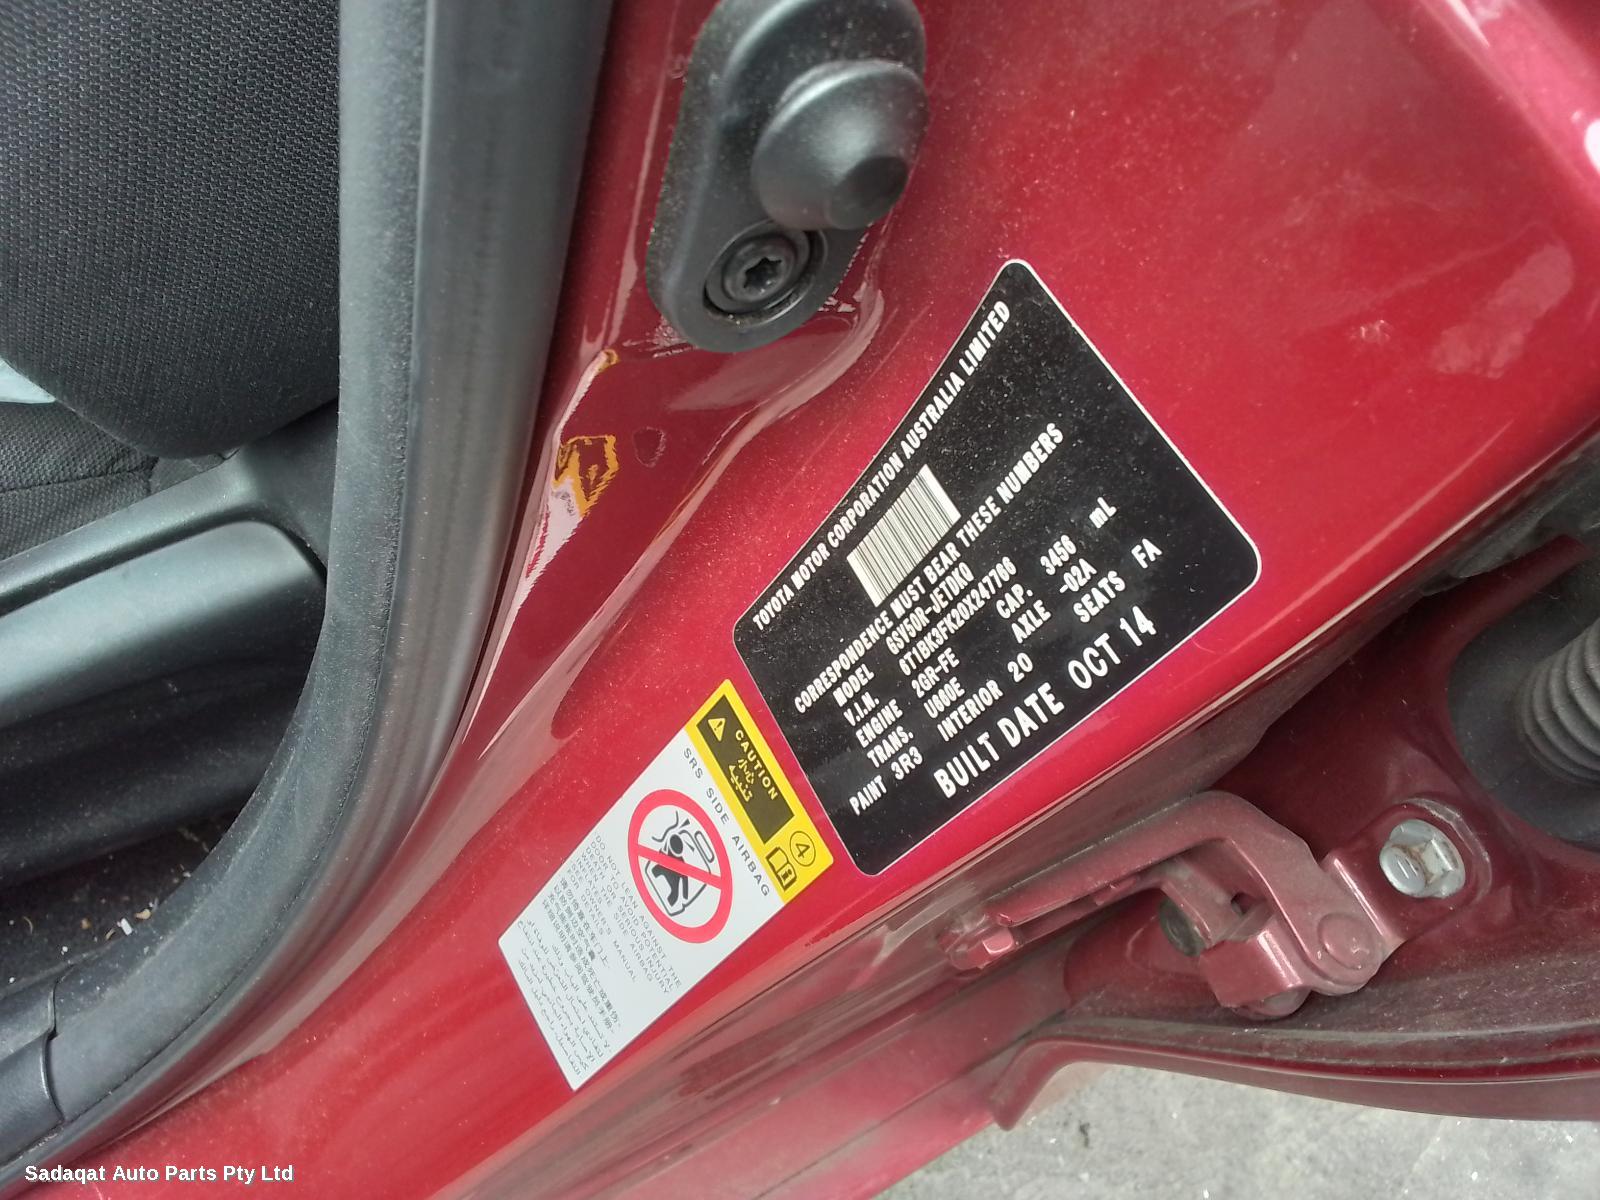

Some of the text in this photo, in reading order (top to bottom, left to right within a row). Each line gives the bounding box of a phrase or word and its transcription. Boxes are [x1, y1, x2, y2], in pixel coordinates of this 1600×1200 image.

[753, 301, 1010, 630] TOYOTA MOTOR CORPORATION AUSTRALIA LIMITED
[794, 423, 1063, 713] CORRESPONDENCE MUST BEAR THESE NUMBERS
[856, 497, 1116, 748] ENGINE 2GR-FE CAP. 3456 mL
[833, 664, 874, 707] MODEL
[844, 692, 879, 726] V.I.N.
[849, 538, 1162, 815] PAINT 3R3 INTERIOR 20 SEATS FA
[867, 726, 913, 768] TRANS.
[1012, 600, 1051, 643] AXLE
[1060, 558, 1097, 593] -02A
[934, 606, 1156, 798] BUILT DATE OCT 14
[682, 745, 771, 897] SRS SIDE AIRBAG
[724, 760, 754, 805] تنبيه
[732, 727, 779, 801] CAUTION
[566, 867, 604, 936] FOR DETAILS
[570, 861, 637, 983] SEE OWNER'S MANUAL
[575, 856, 603, 905] INFLATES
[580, 850, 654, 983] WHEN THE SIDE AIRBAG
[585, 844, 669, 996] DEATH OR SERIOUS INJURY
[590, 839, 675, 991] DOOR TO AVOID POTENTIAL
[595, 833, 682, 988] DO NOT LEAN AGAINST THE
[794, 842, 811, 860] 4
